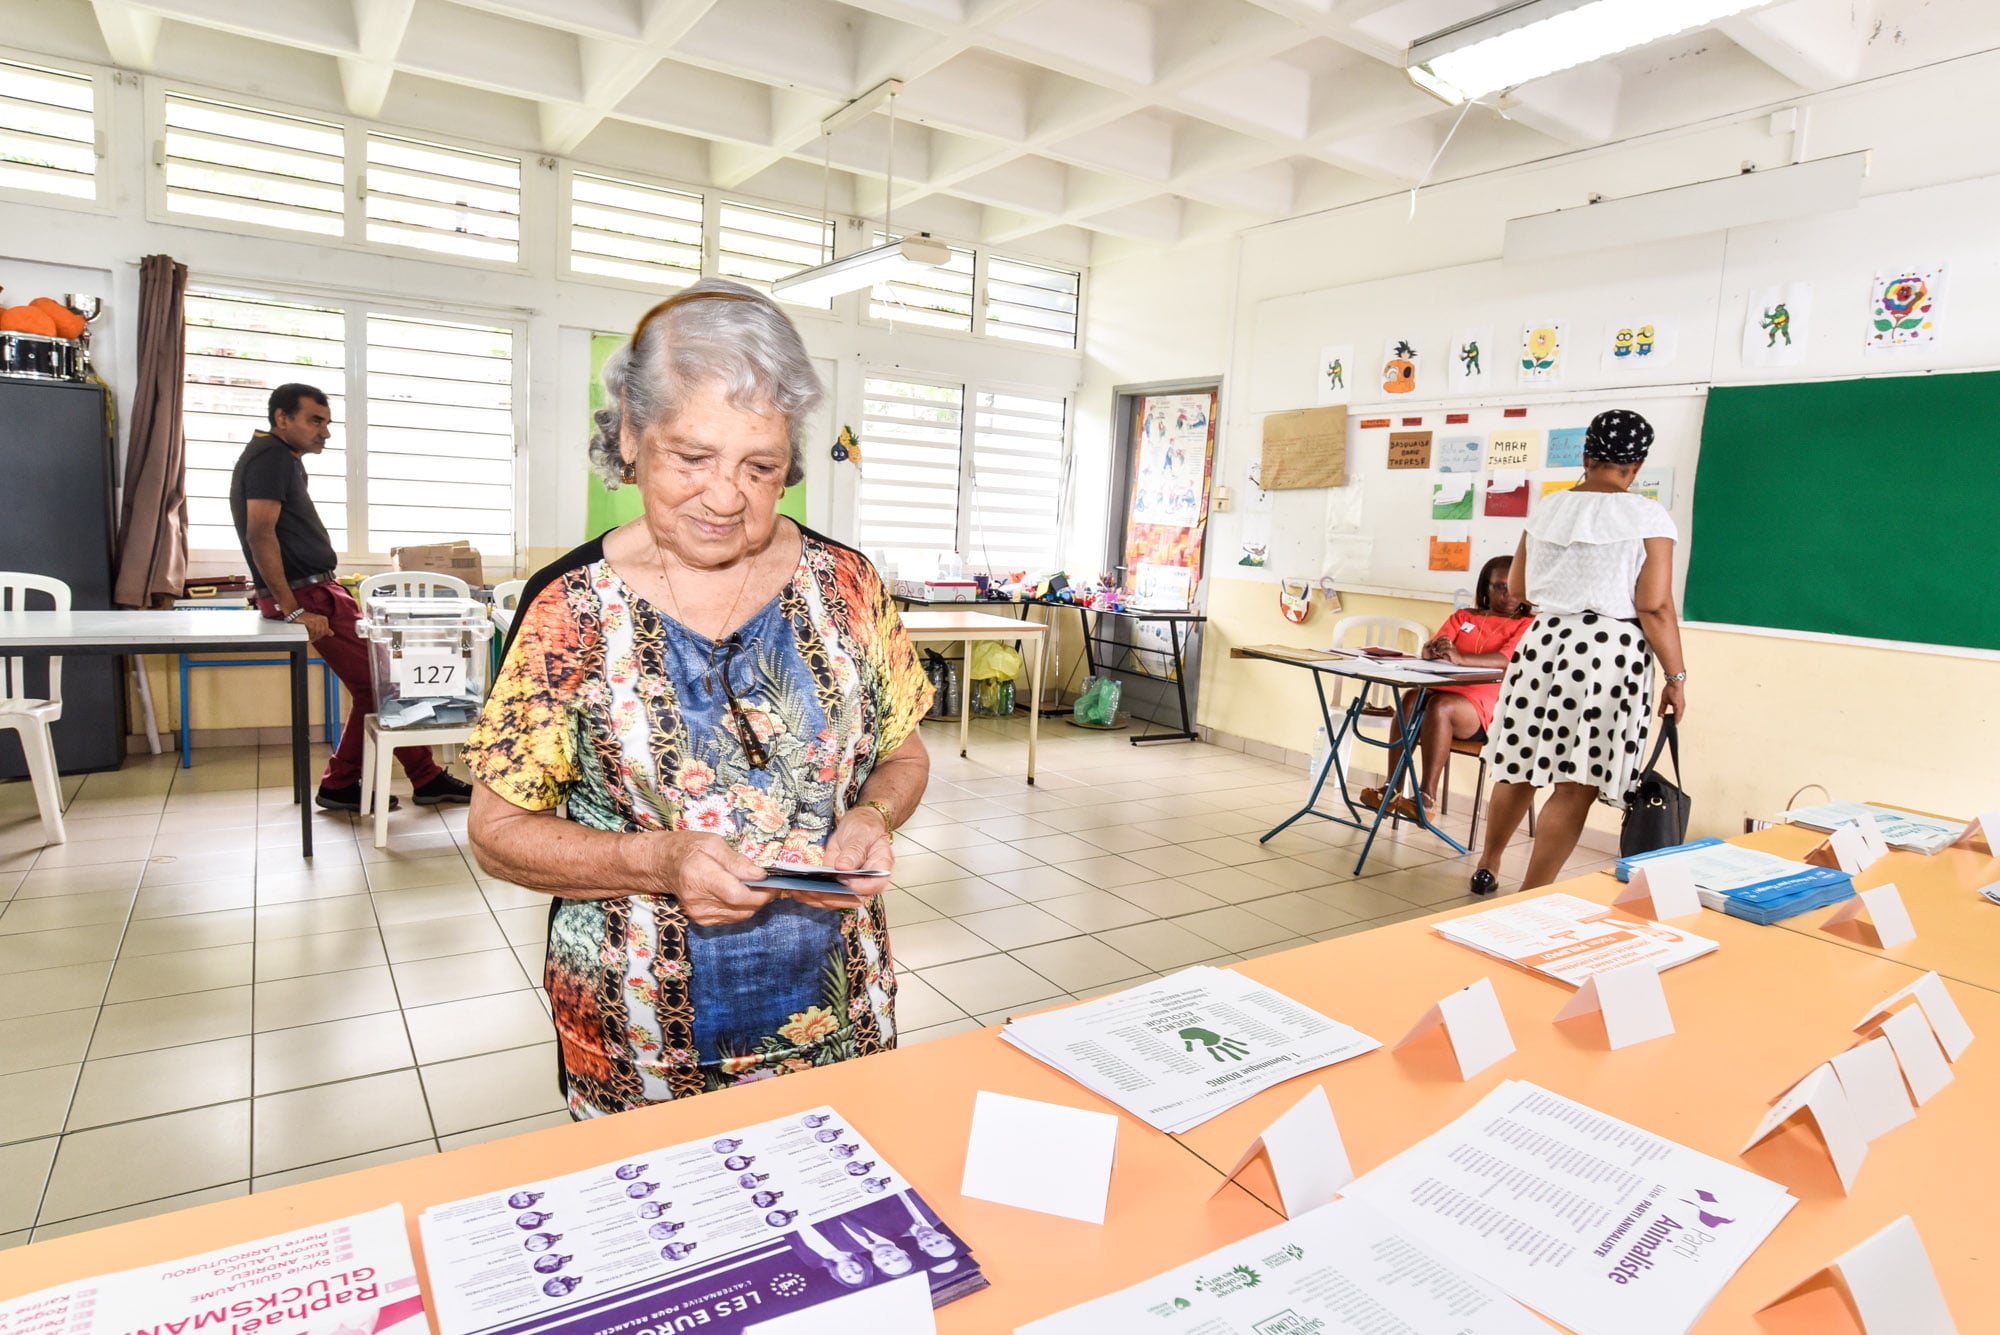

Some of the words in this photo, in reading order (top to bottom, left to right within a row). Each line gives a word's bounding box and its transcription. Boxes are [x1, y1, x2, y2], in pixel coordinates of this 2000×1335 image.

[413, 665, 455, 684] 127
[1155, 1015, 1205, 1034] URGENCE
[1241, 1055, 1289, 1075] Dominique
[1205, 1069, 1244, 1087] BOURG
[1648, 1184, 1667, 1200] Liste
[1627, 1199, 1653, 1217] PARTI
[286, 1231, 328, 1247] Pierre
[1593, 1215, 1637, 1258] ANIMALISTE
[1671, 1227, 1717, 1263] Parti
[280, 1240, 329, 1258] Aurore
[304, 1250, 330, 1261] Eric
[1608, 1213, 1684, 1285] Animaliste
[161, 1243, 281, 1281] LARROUTUROU
[213, 1254, 276, 1277] LALUCQ
[231, 1258, 297, 1282] ANDRIEU
[287, 1258, 331, 1276] Sylvie
[190, 1271, 282, 1303] GUILLAUME
[778, 1278, 798, 1291] udi
[1209, 1274, 1248, 1293] écologie
[1217, 1284, 1243, 1298] europe
[129, 1266, 376, 1335] GLUCKSMAN
[683, 1280, 752, 1309] L'ALTERNATIVE
[713, 1290, 762, 1317] LES
[15, 1294, 71, 1315] Karine
[232, 1282, 379, 1335] Raphaël
[650, 1304, 680, 1319] POUR
[15, 1305, 68, 1325] Roger
[5, 1316, 66, 1335] Perne
[593, 1316, 648, 1335] RELANCE
